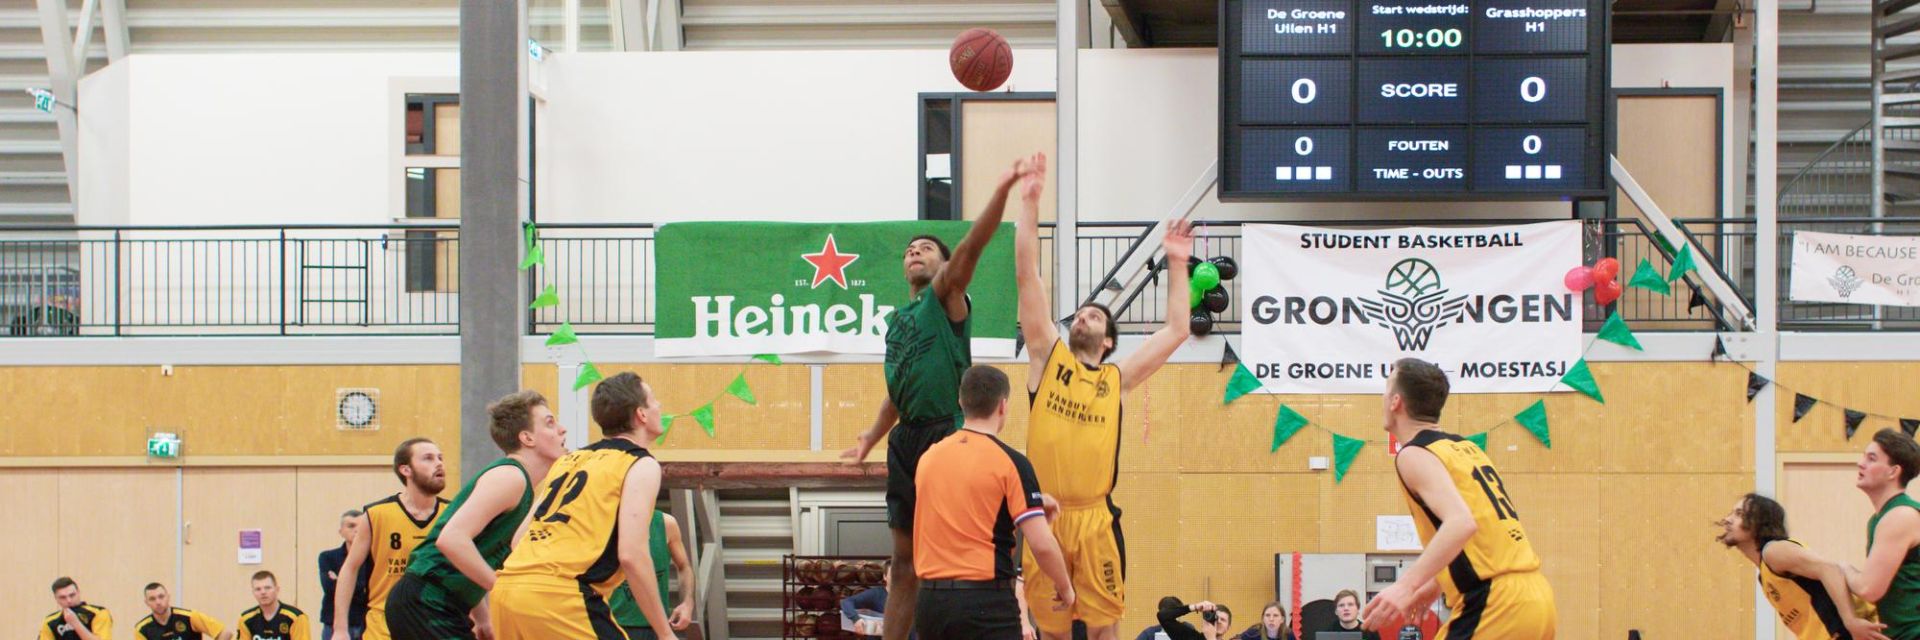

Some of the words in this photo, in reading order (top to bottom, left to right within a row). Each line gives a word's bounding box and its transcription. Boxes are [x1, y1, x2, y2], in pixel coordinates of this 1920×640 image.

[1267, 8, 1288, 20] De
[1290, 8, 1346, 20] Groene
[1372, 4, 1403, 15] Start
[1405, 3, 1469, 16] wedstrijd:
[1485, 6, 1587, 20] Grasshoppers
[1274, 22, 1314, 34] Uilen
[1317, 23, 1338, 34] H1
[1525, 21, 1545, 33] H1
[1381, 28, 1462, 48] 10:00
[1291, 77, 1317, 104] 0
[1380, 83, 1458, 98] SCORE
[1520, 76, 1546, 103] 0
[1294, 136, 1314, 156] 0
[1388, 140, 1449, 151] FOUTEN
[1522, 134, 1542, 155] 0
[1373, 168, 1409, 179] TIME
[1422, 168, 1464, 179] OUTS
[1300, 233, 1391, 249] STUDENT
[1398, 232, 1524, 249] BASKETBALL
[1814, 242, 1840, 256] AM
[1845, 245, 1917, 259] BECAUSE
[1872, 272, 1892, 285] De
[691, 293, 896, 338] Heinek
[1055, 363, 1073, 387] 14
[1256, 363, 1280, 379] DE
[1287, 363, 1374, 379] GROENE
[1460, 361, 1567, 379] MOESTASJ
[533, 469, 588, 525] 12
[1471, 465, 1520, 521] 13
[390, 532, 402, 550] 8
